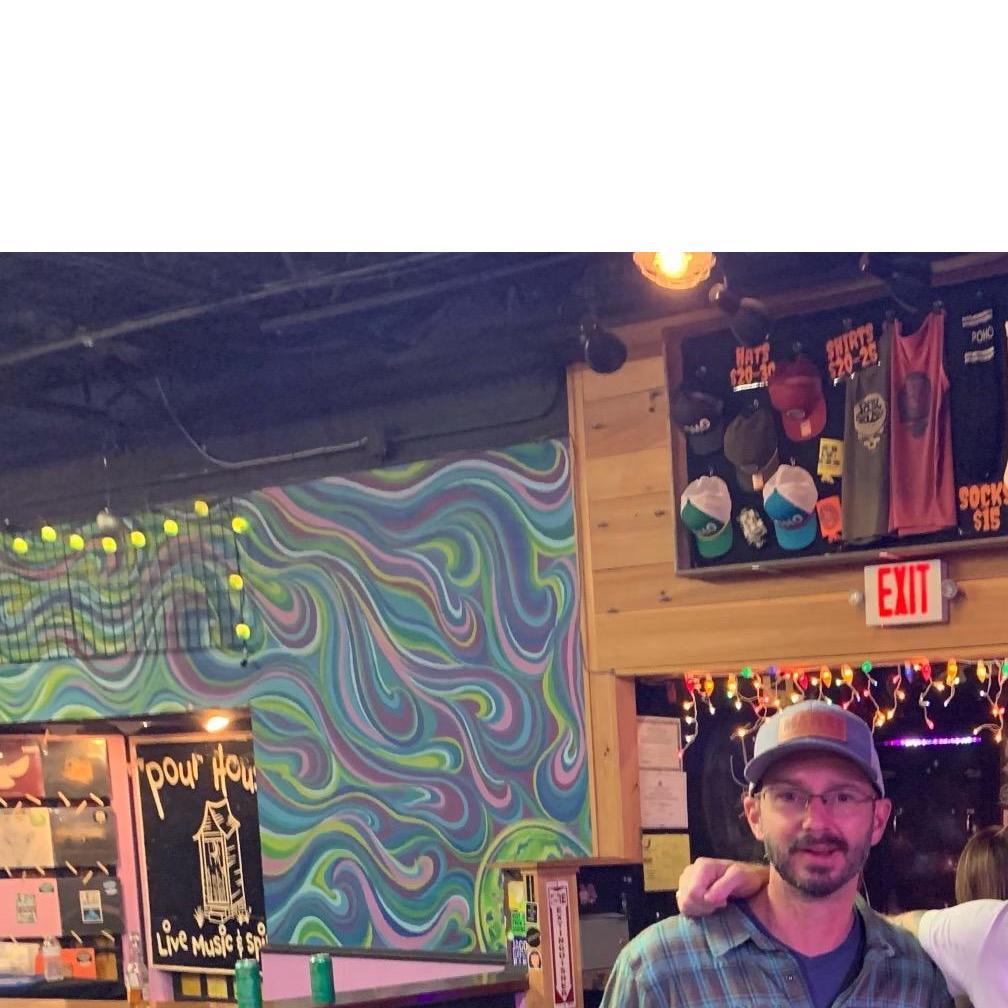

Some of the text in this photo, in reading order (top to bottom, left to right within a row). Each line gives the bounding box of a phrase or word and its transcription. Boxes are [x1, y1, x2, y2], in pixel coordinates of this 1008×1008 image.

[826, 322, 874, 363] SHIRTS
[971, 326, 994, 344] POHO
[736, 342, 770, 367] HATS
[973, 507, 1000, 532] $15
[877, 562, 930, 617] EXIT
[213, 743, 258, 797] Hou
